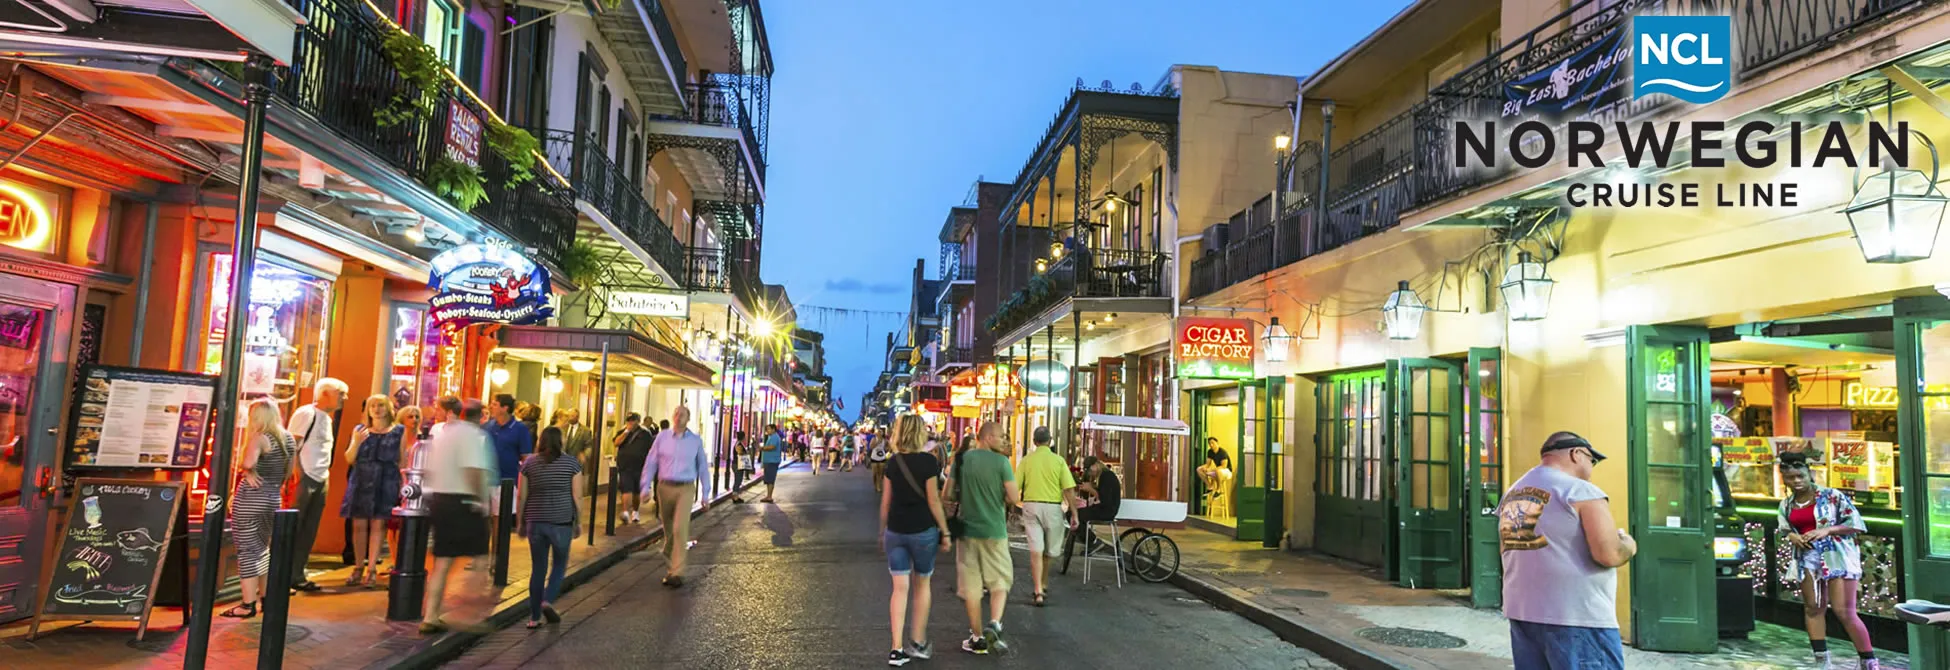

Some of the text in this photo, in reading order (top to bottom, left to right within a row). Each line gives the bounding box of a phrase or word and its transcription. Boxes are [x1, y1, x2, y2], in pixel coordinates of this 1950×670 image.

[1502, 45, 1634, 117] Big Easy Bachelor
[450, 123, 479, 156] RENTALS
[484, 236, 513, 250] Olde
[466, 293, 493, 305] Steaks
[469, 306, 502, 319] Seafood
[504, 304, 533, 320] Oysters
[1186, 326, 1248, 344] CIGAR
[1181, 343, 1253, 359] FACTORY
[1832, 441, 1869, 460] PIZZ
